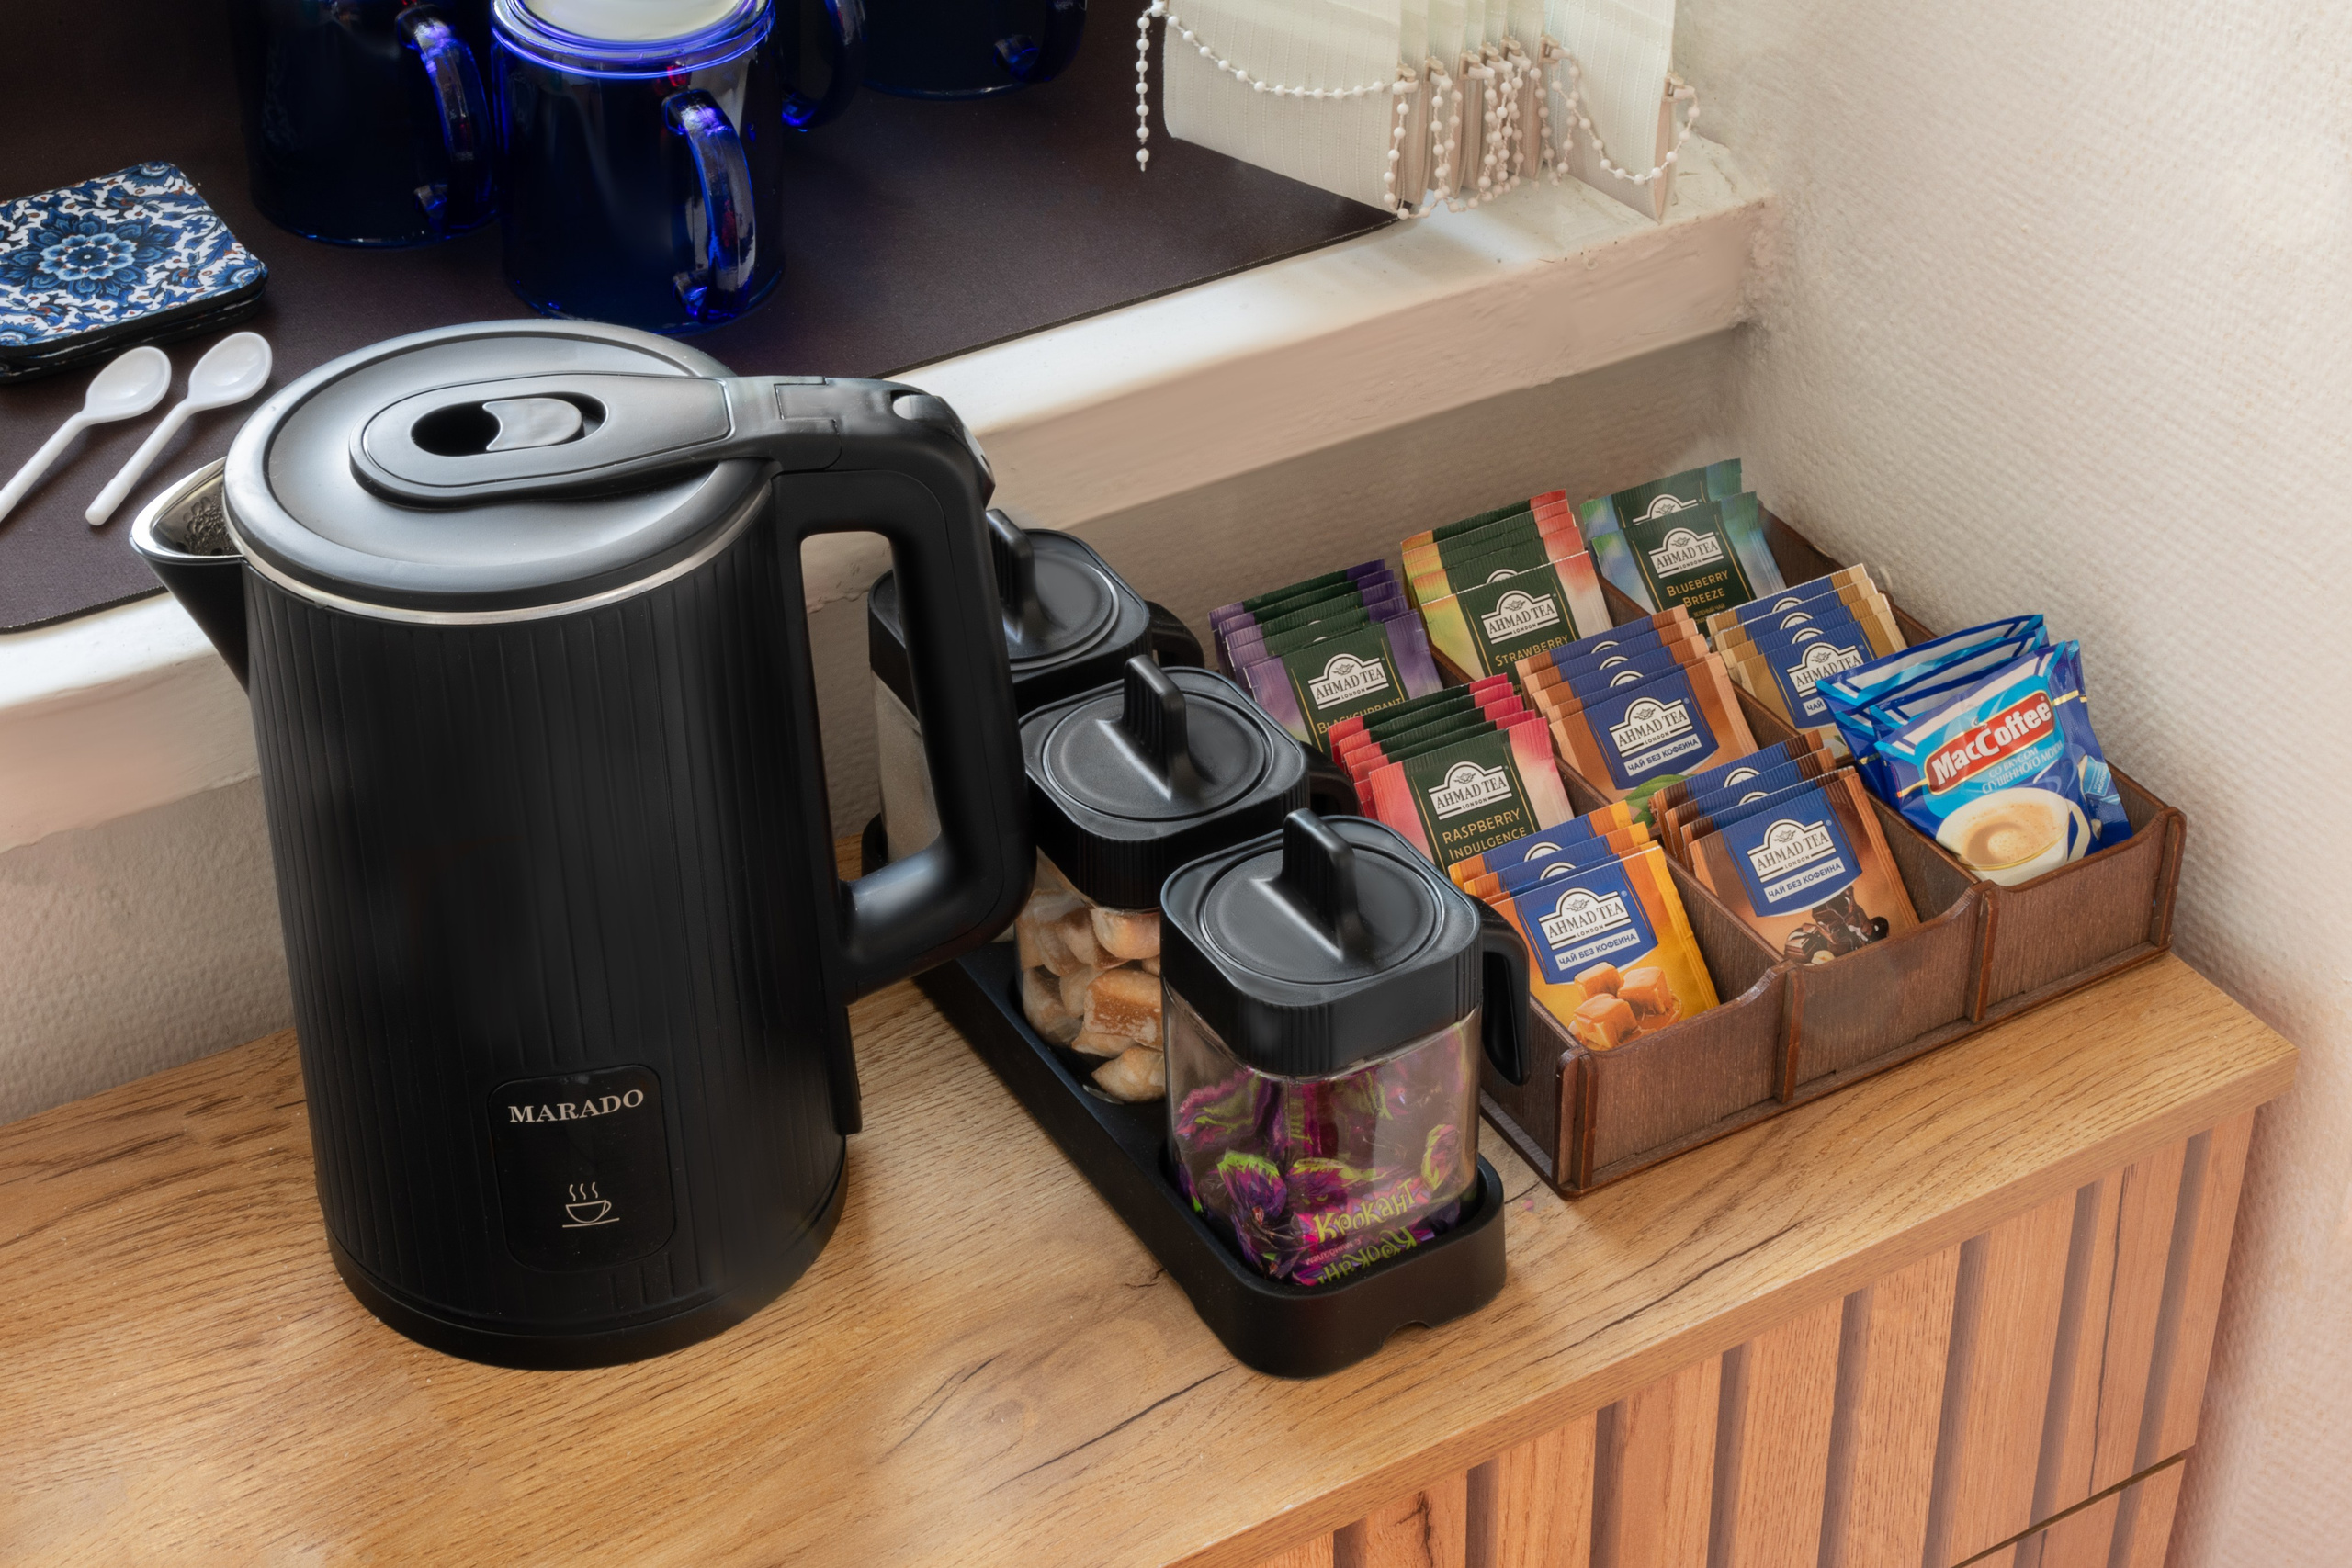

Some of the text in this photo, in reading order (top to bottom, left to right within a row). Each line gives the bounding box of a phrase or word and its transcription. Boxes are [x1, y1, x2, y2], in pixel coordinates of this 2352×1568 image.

[1657, 540, 1719, 569] AHMAD TEA
[1679, 558, 1702, 570] LONDON
[1666, 570, 1729, 597] BLUEBERRY
[1682, 587, 1725, 607] BREEZE
[1489, 603, 1555, 634] AHMAD TEA
[1512, 623, 1537, 634] LONDON
[1495, 634, 1568, 667] STRAWBERRY
[1316, 667, 1384, 699] AHMAD TEA
[1795, 655, 1861, 687] AHMAD TEA
[1340, 688, 1366, 700] LONDON
[1806, 700, 1824, 711] ЧАЙ
[1618, 709, 1688, 747] AHMAD TEA
[1645, 731, 1669, 745] LONDON
[1931, 701, 2052, 786] MacCoffee
[1627, 739, 1699, 771] ЧАЙ БЕЗ КОФЕИНА
[1988, 747, 2039, 778] СО ВКУСОМ
[1436, 775, 1507, 809] AHMAD TEA
[1462, 797, 1487, 809] LONDON
[1442, 807, 1520, 844] RASPBERRY
[1448, 826, 1527, 861] INDULGENCE
[1757, 831, 1829, 871] AHMAD TEA
[1784, 855, 1810, 869] LONDON
[1768, 863, 1841, 897] ЧАЙ БЕЗ КОФЕИНА
[1548, 902, 1624, 938] AHMAD TEA
[1577, 924, 1604, 938] LONDON
[1558, 933, 1637, 965] ЧАЙ БЕЗ КОФЕИНА
[507, 1089, 645, 1123] MARADO
